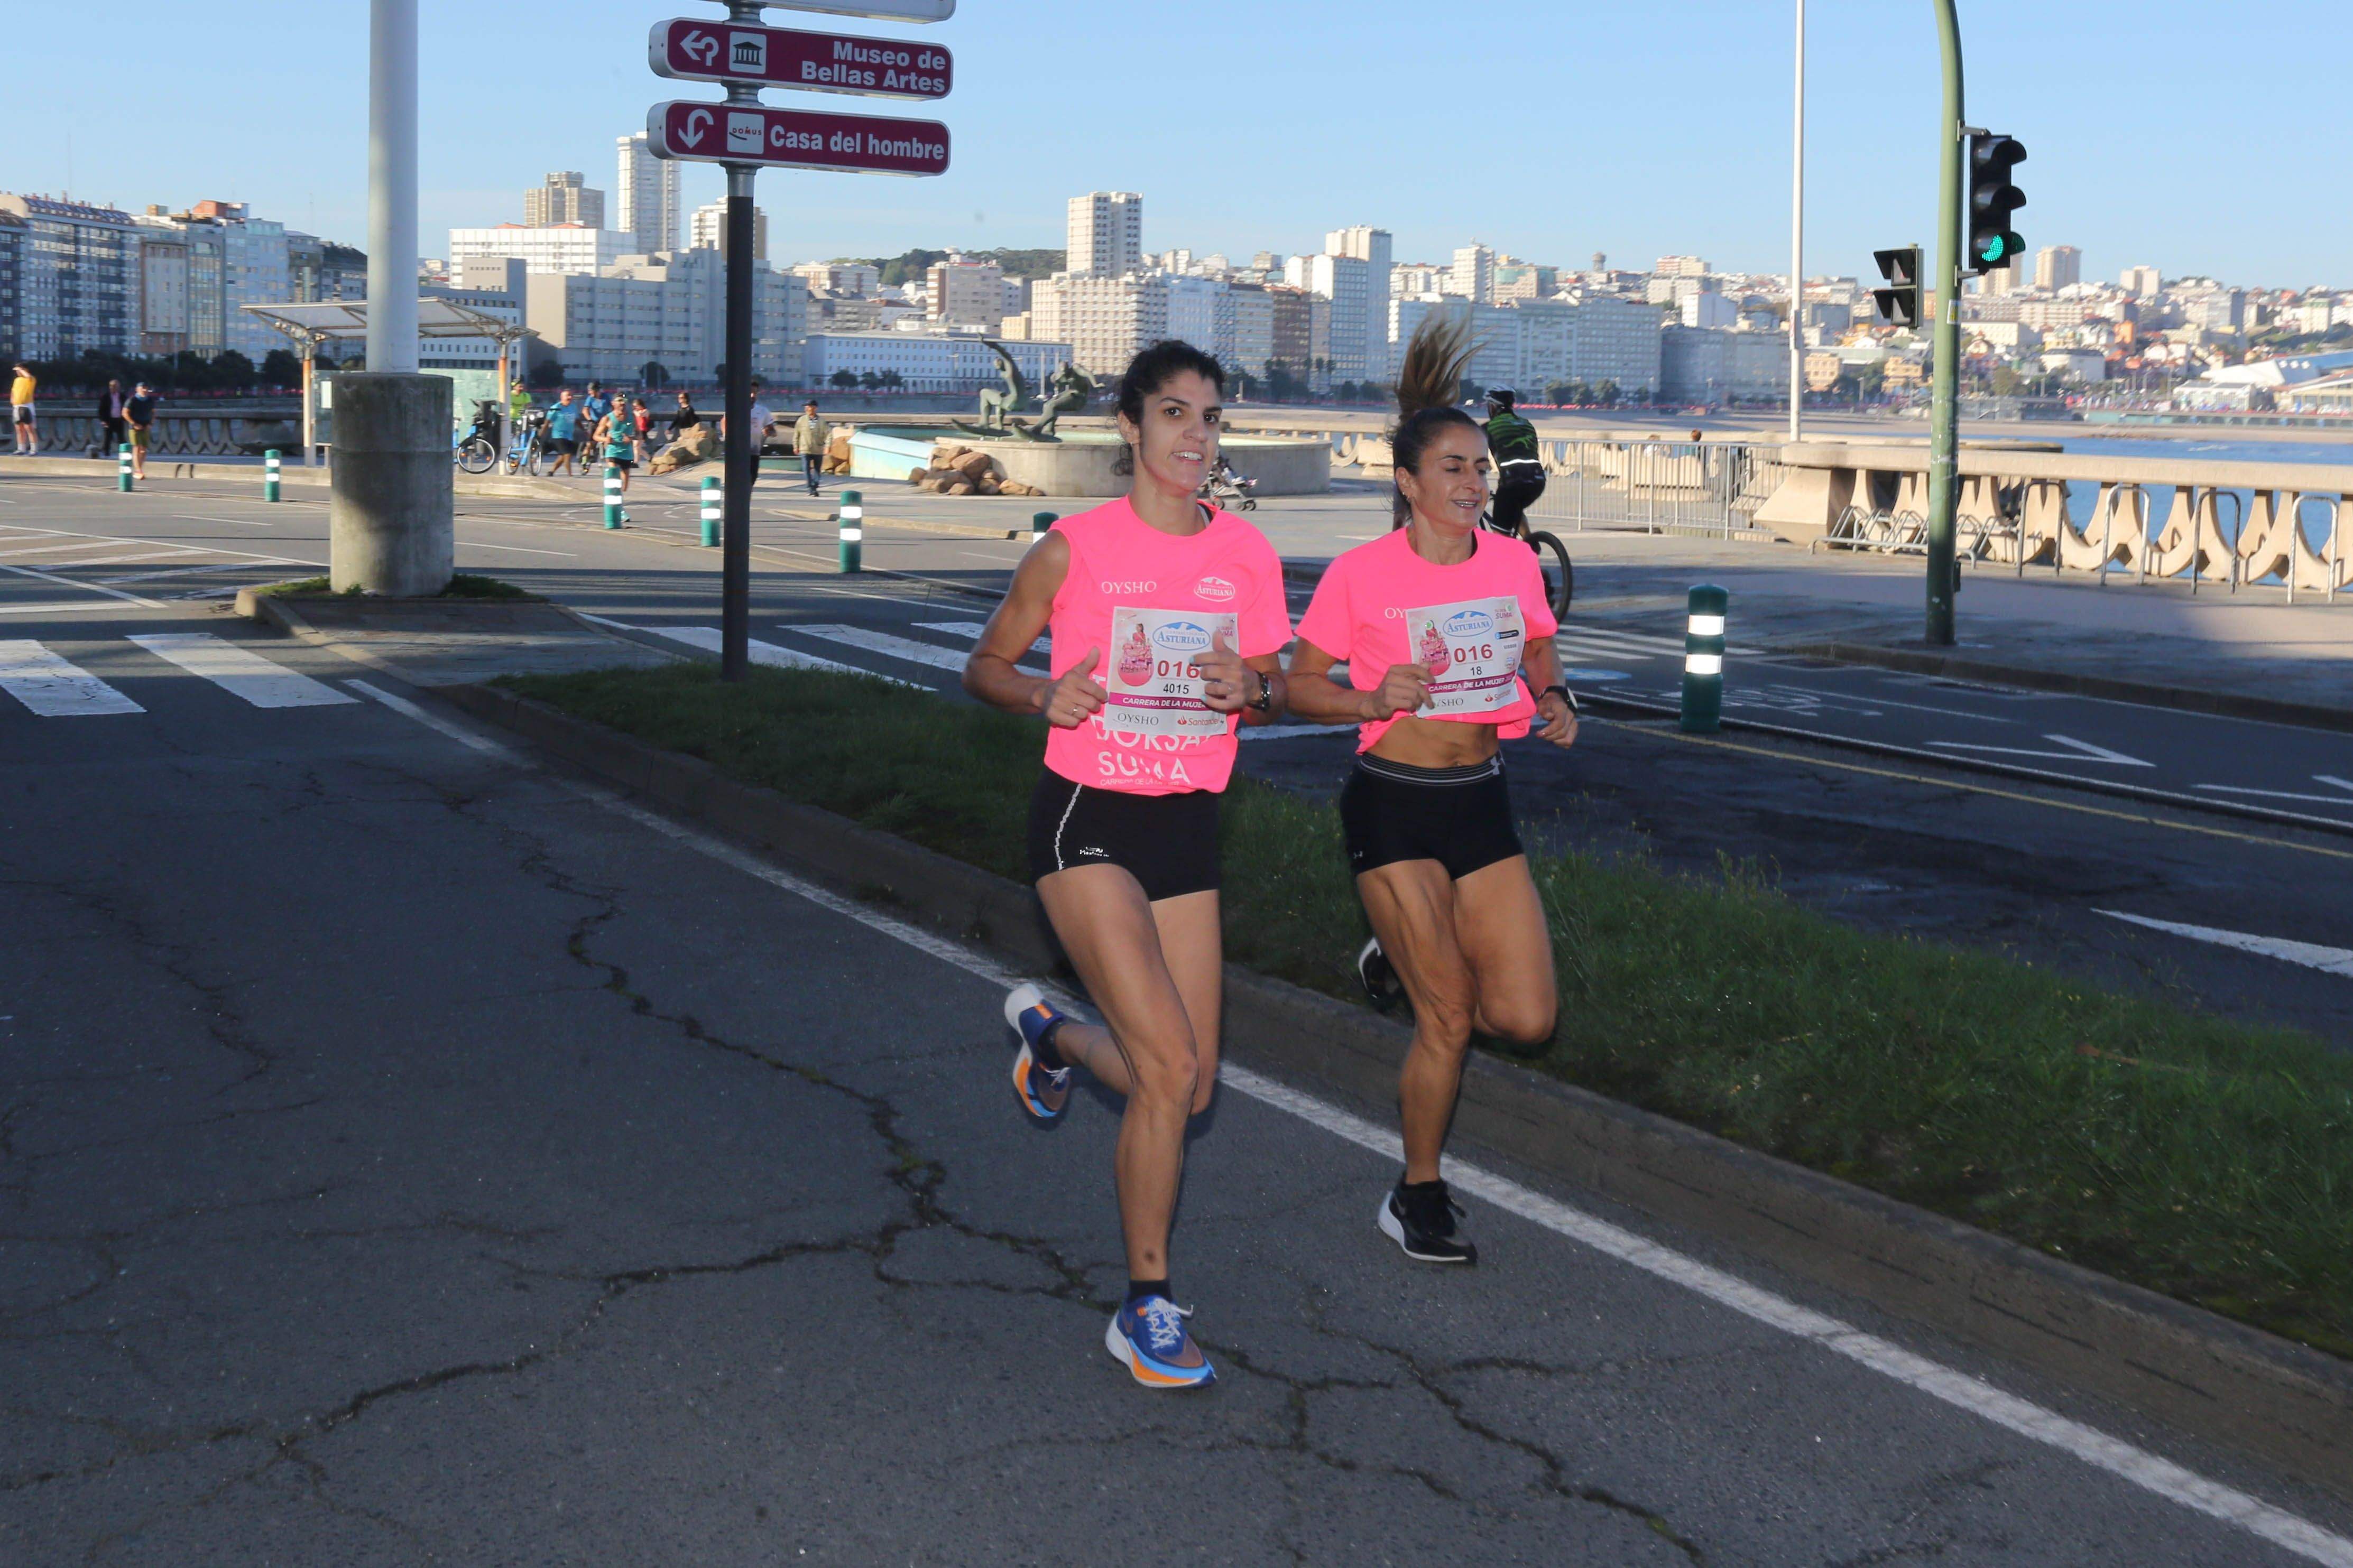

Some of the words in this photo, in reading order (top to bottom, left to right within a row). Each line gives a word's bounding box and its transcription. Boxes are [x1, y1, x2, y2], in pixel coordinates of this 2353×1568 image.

[833, 40, 910, 67] Museo
[917, 49, 946, 70] de
[801, 60, 876, 86] Bellas
[882, 69, 945, 93] Artes
[732, 126, 762, 136] DOMUS
[770, 125, 823, 151] Casa
[829, 131, 861, 154] del
[868, 133, 945, 160] hombre
[1101, 581, 1157, 595] OYSHO
[1196, 583, 1233, 597] ASTURIANA
[1447, 620, 1490, 633] ASTURIANA
[1157, 630, 1206, 645] ASTURIANA
[1454, 644, 1493, 663] 016
[1157, 660, 1201, 679] 016
[1470, 666, 1482, 676] 18
[1163, 683, 1189, 694] 4015
[1428, 683, 1462, 692] CARRERA
[1122, 697, 1160, 707] CARRERA
[1118, 713, 1159, 726] OYSHO
[1188, 718, 1220, 727] Santander
